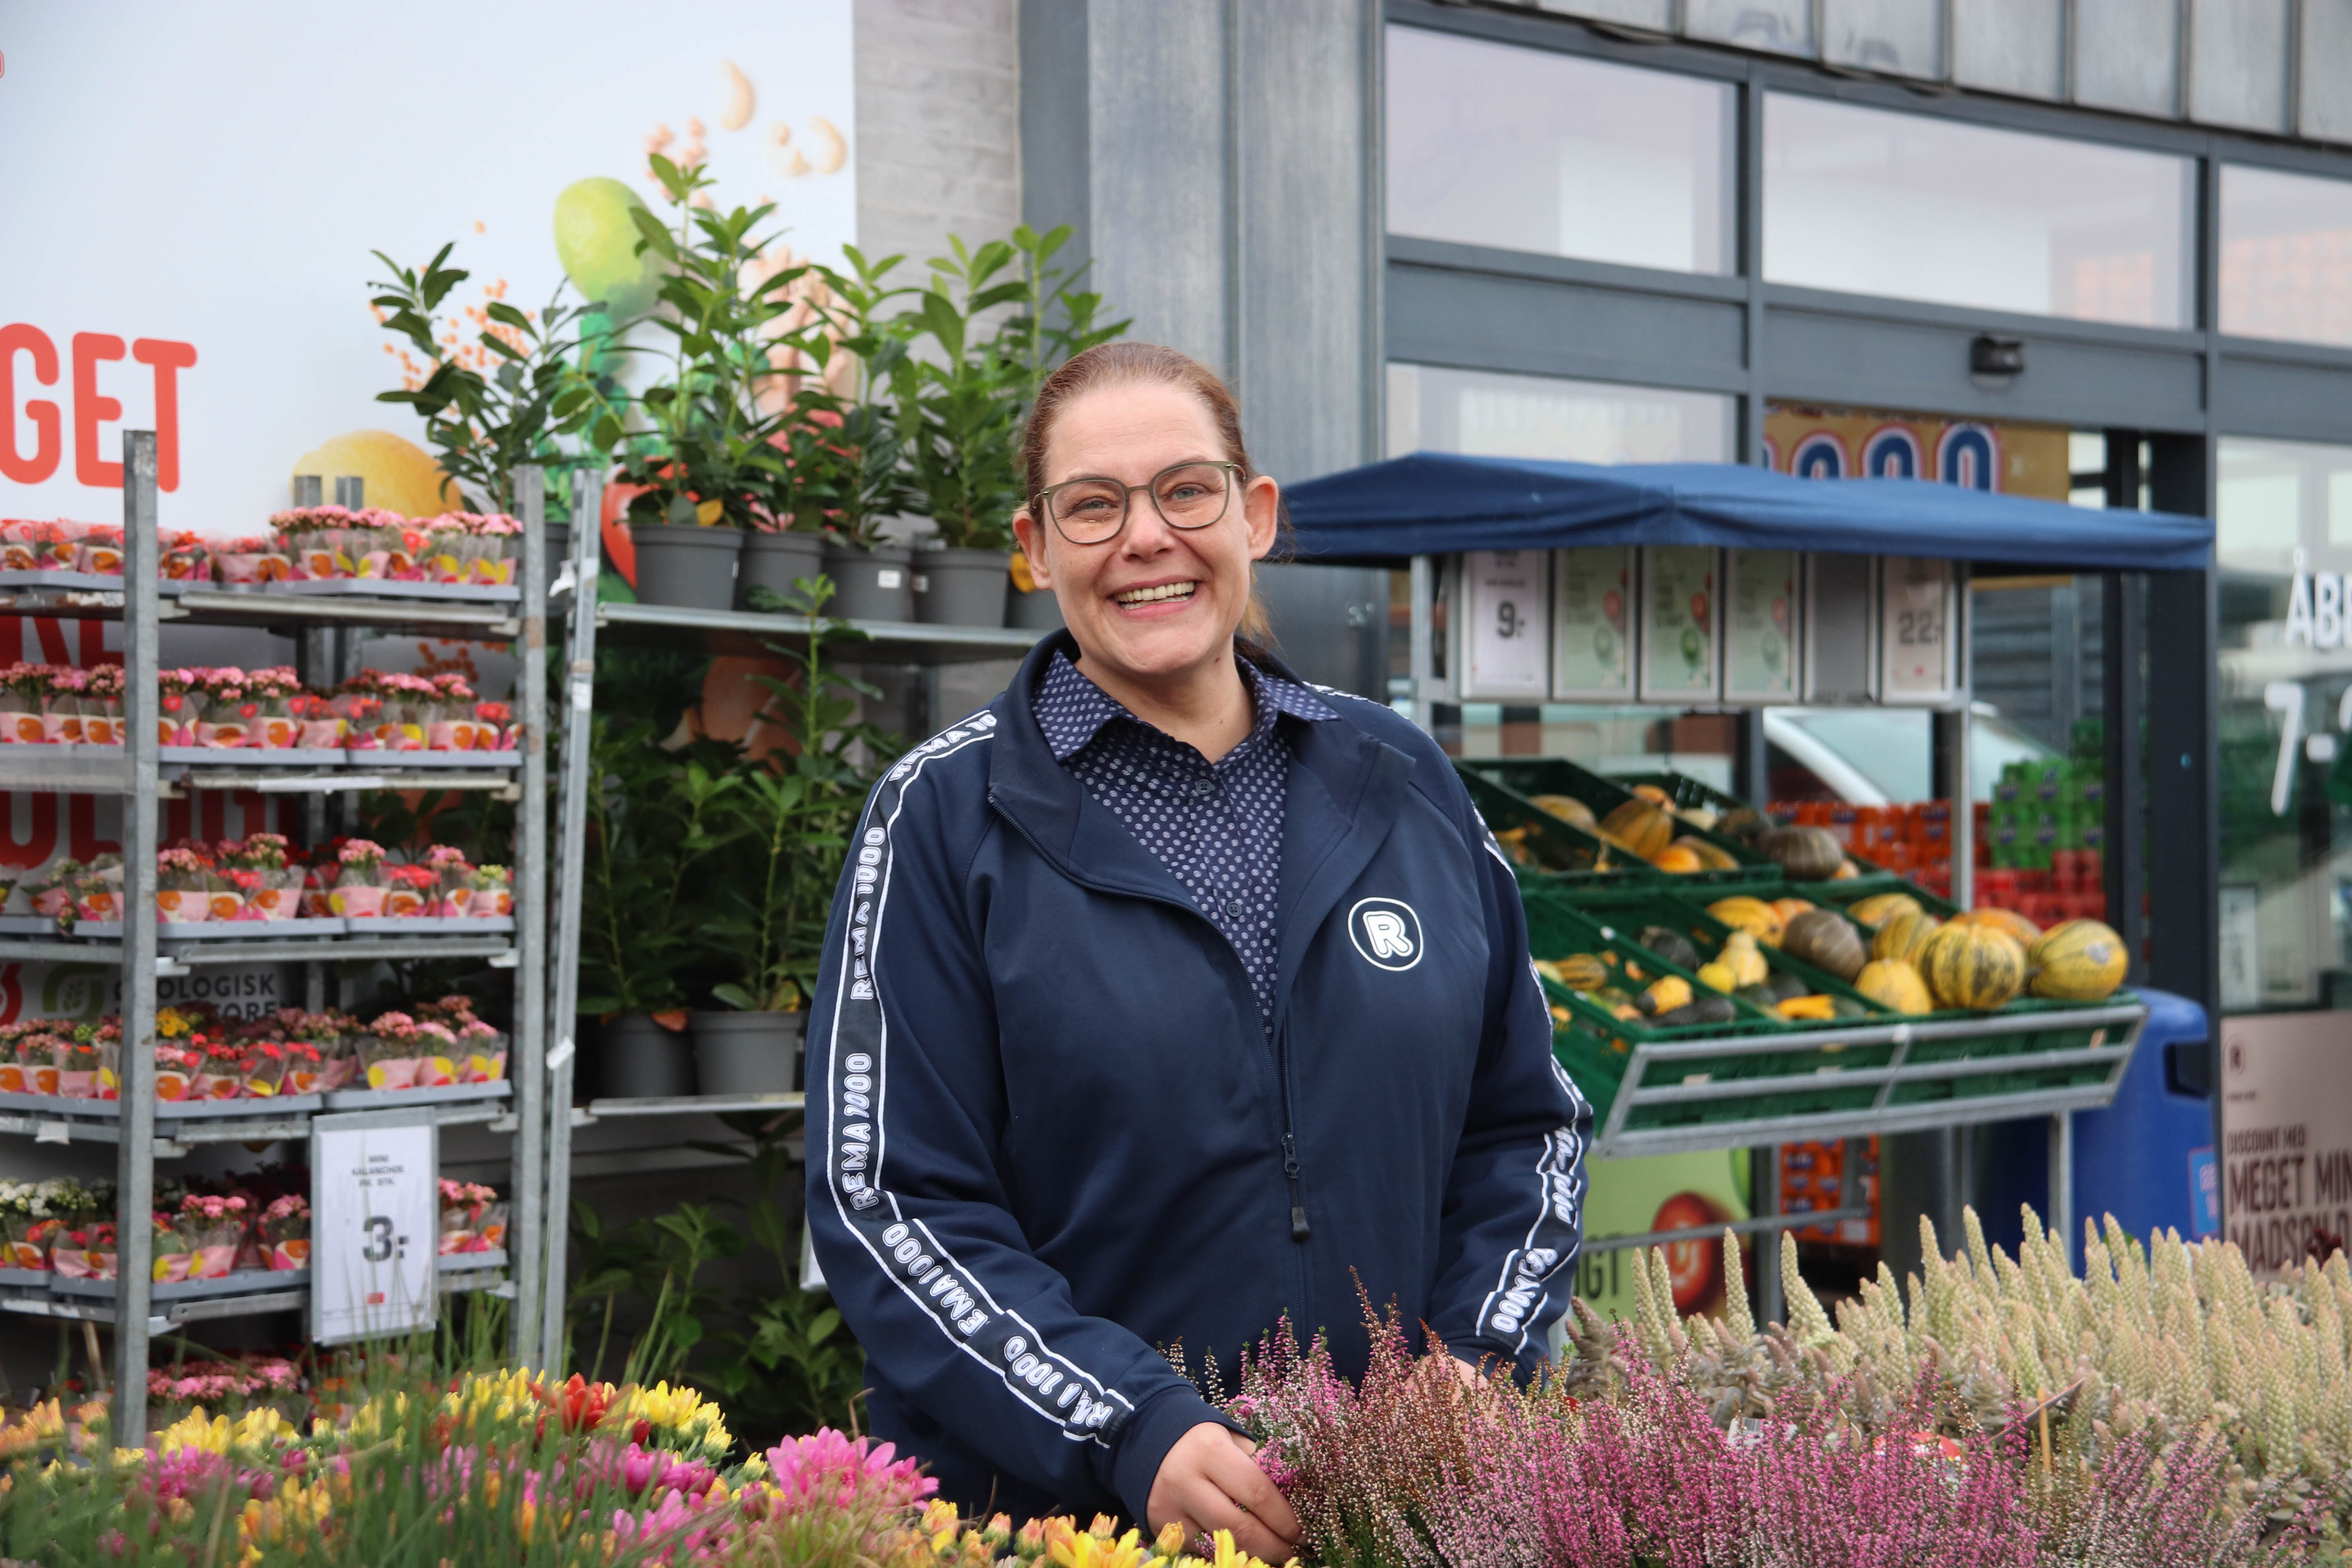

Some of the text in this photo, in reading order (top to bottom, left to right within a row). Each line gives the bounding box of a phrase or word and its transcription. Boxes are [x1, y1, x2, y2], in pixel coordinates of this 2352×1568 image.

[850, 827, 886, 1000] REMA 1000
[1363, 911, 1414, 958] R
[841, 1053, 879, 1210] REMA 1000
[2227, 1126, 2280, 1154] DISCOUNT
[2229, 1154, 2305, 1216] MEGET
[882, 1223, 990, 1336] EMA 1000
[1004, 1336, 1063, 1394] 1000
